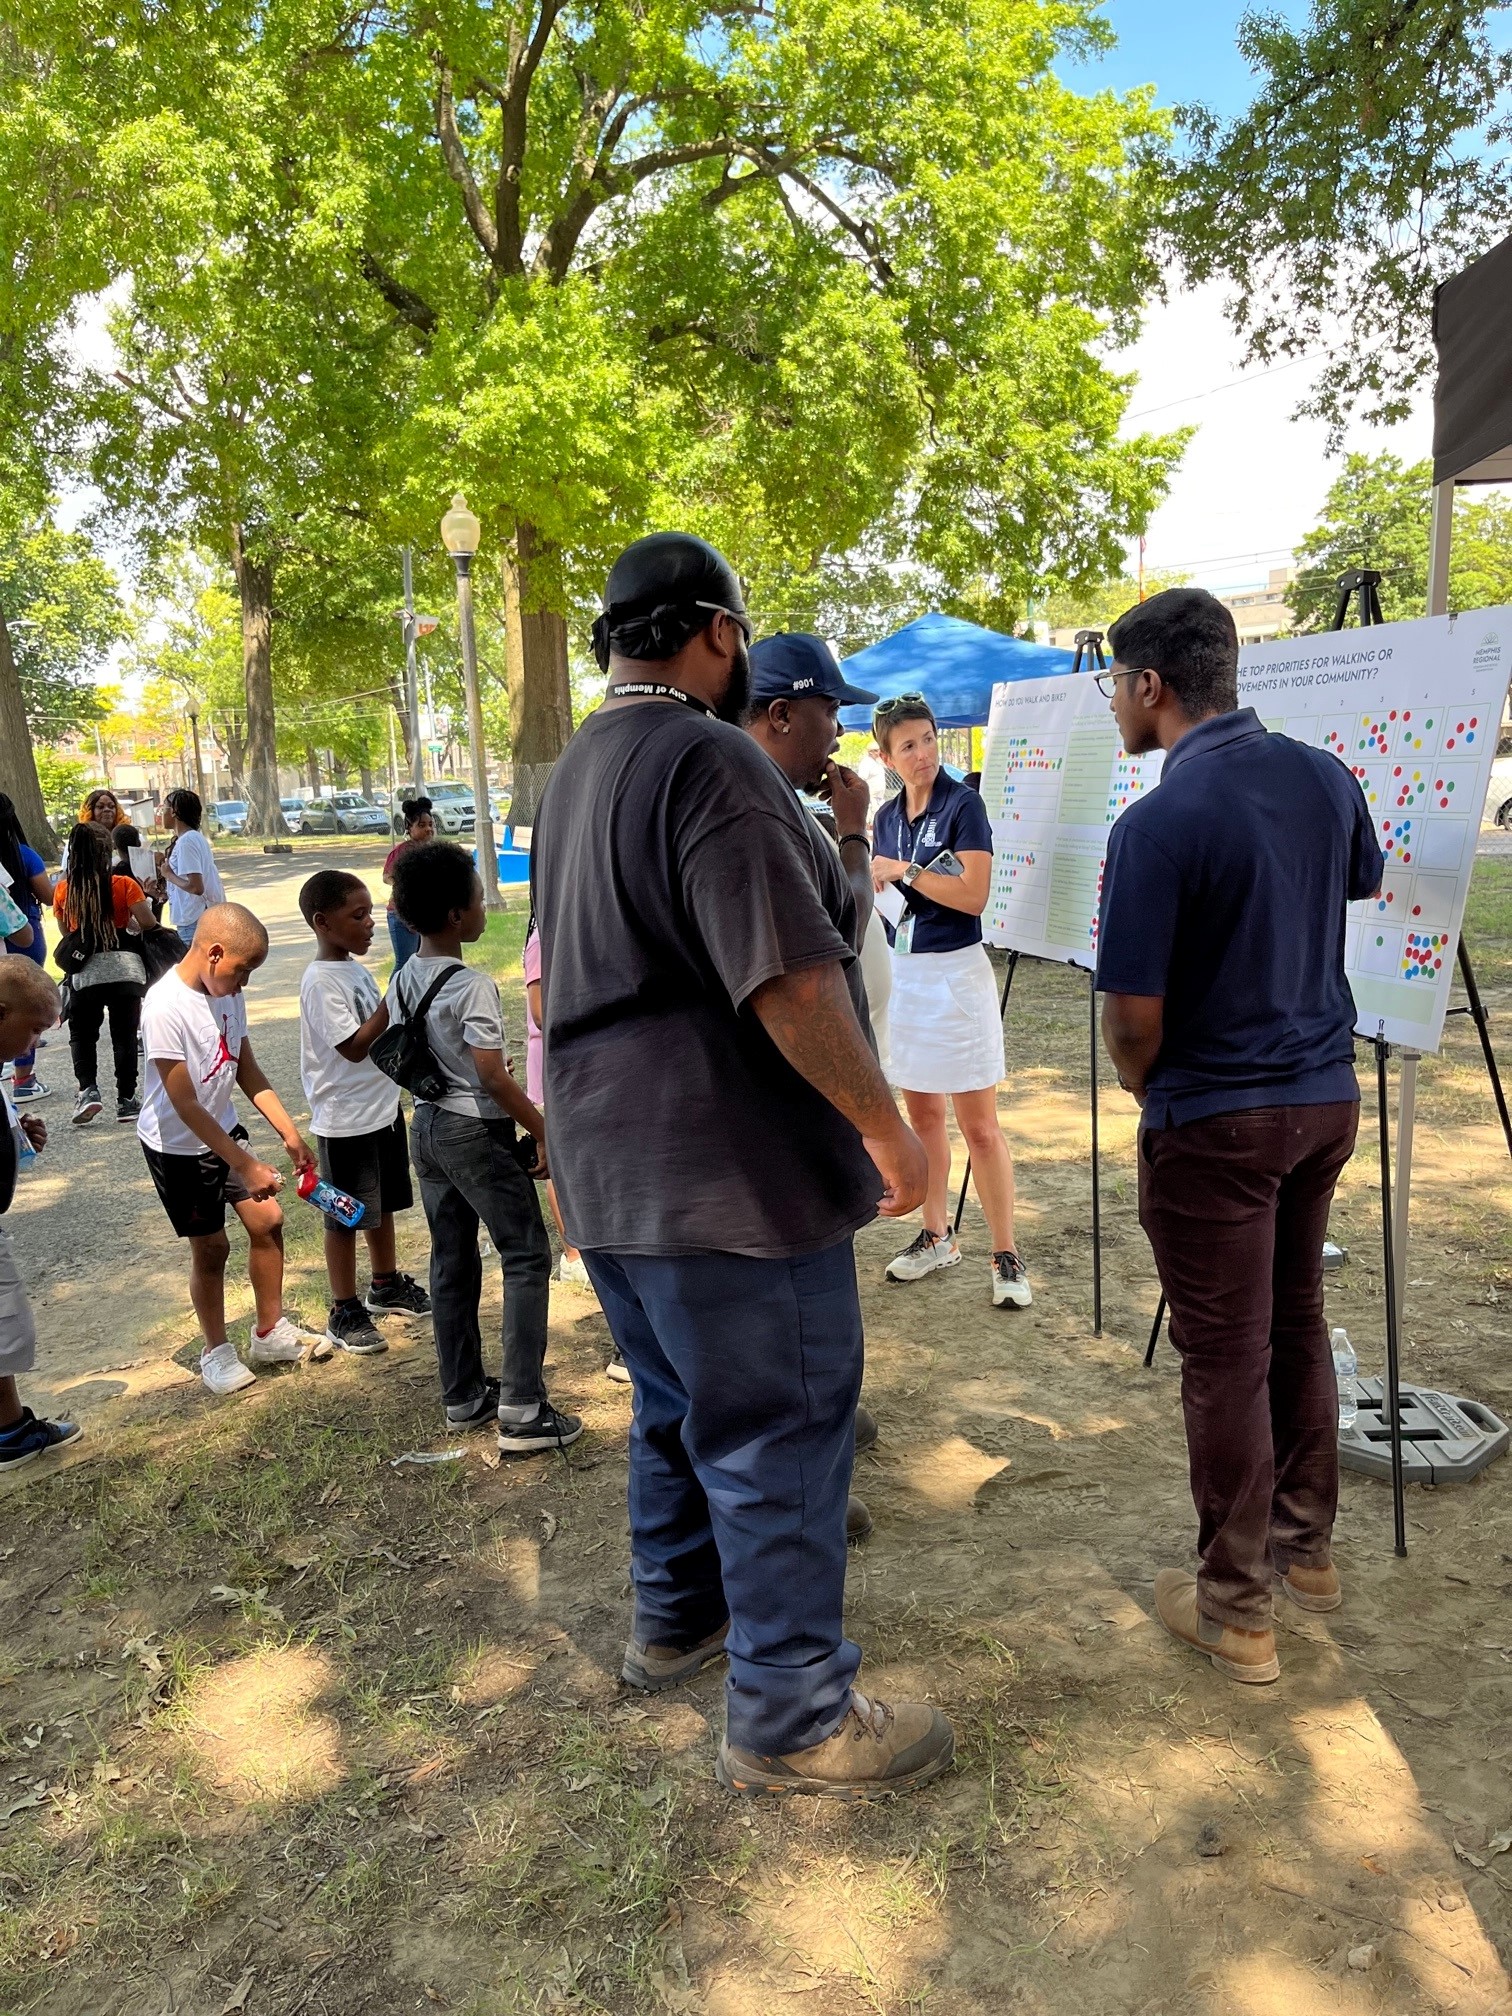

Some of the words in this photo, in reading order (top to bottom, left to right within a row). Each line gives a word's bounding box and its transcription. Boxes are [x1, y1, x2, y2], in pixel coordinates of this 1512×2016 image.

[1237, 666, 1247, 677] HE
[1250, 665, 1265, 676] TOP
[1266, 659, 1310, 675] PRIORITIES
[1311, 657, 1329, 669] FOR
[1332, 651, 1375, 666] WALKING
[1378, 648, 1393, 661] OR
[1473, 655, 1500, 664] REGIONAL
[792, 677, 814, 691] #901
[1237, 679, 1277, 693] OVEMENTS
[1279, 678, 1289, 689] IN
[1291, 675, 1314, 687] YOUR
[1315, 667, 1379, 685] COMMUNITY?
[614, 683, 653, 696] Memphis
[655, 685, 667, 694] of
[668, 687, 687, 702] City
[1025, 696, 1038, 704] WALK
[1039, 694, 1050, 702] AND
[1051, 692, 1067, 701] BIKE?
